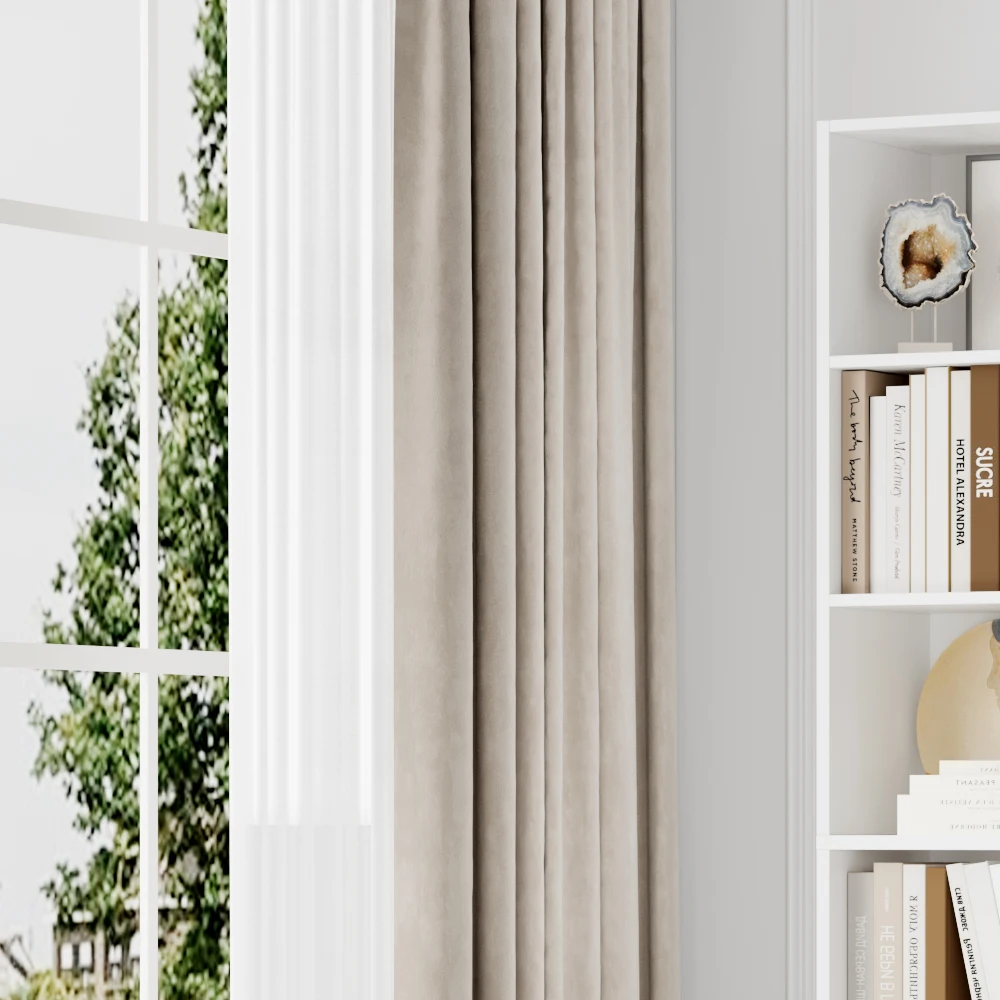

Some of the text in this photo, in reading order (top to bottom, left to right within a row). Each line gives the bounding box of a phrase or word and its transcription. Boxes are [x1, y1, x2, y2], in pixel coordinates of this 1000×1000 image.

[848, 389, 860, 419] The
[890, 404, 906, 499] Karen McCartney
[975, 447, 994, 498] SUCRE
[956, 439, 965, 546] HOTEL ALEXANDRA
